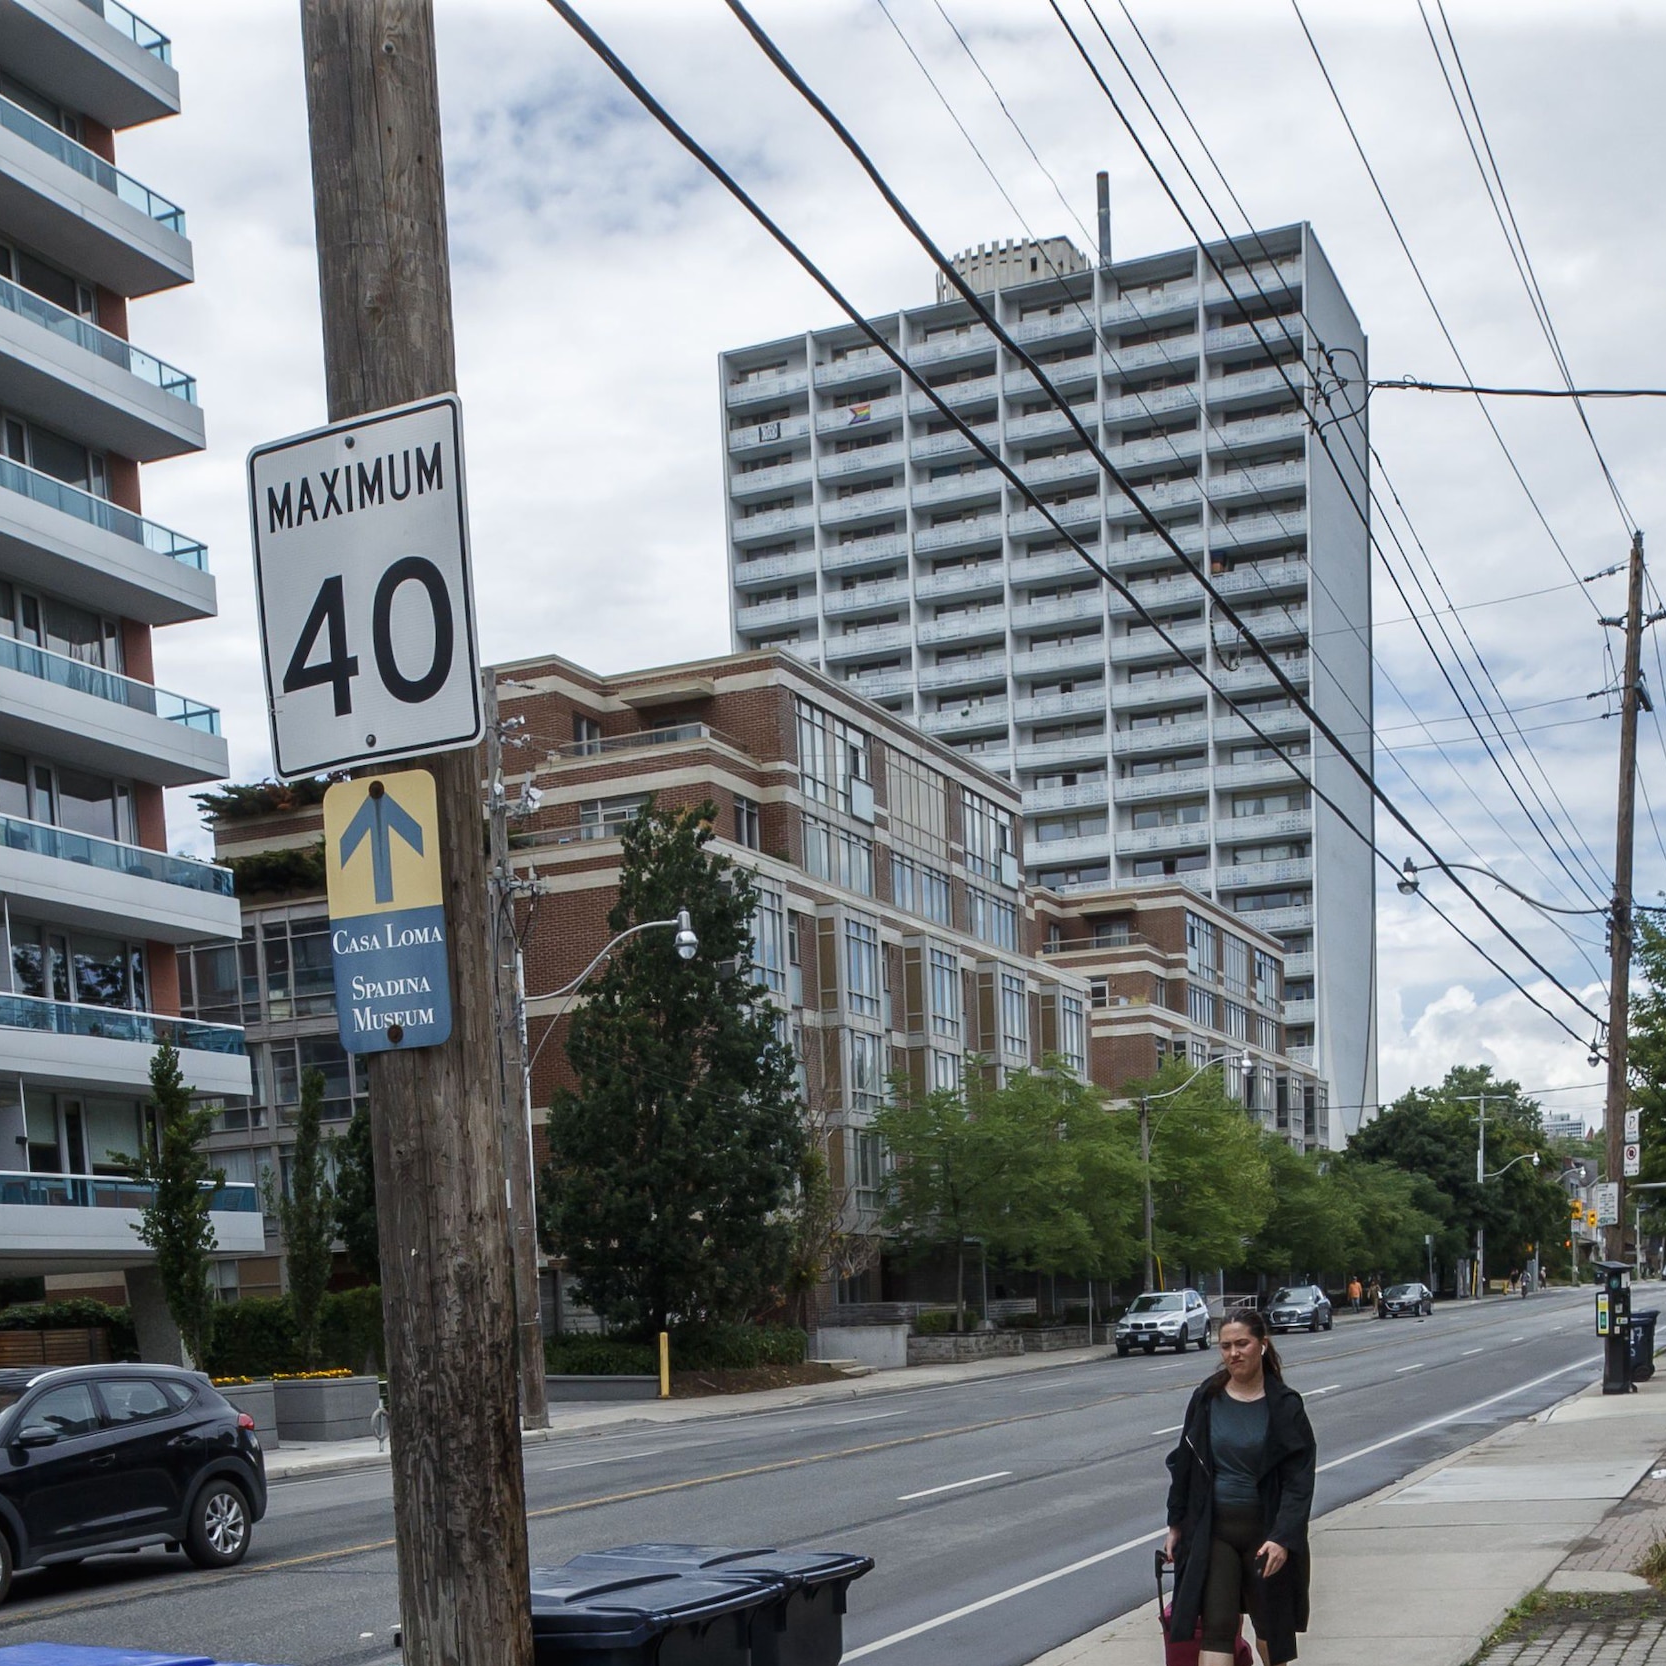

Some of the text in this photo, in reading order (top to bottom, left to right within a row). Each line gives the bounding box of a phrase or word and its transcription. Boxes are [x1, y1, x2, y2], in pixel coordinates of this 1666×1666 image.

[267, 442, 443, 533] MAXIMUM
[283, 556, 454, 717] 40
[332, 920, 444, 955] CASA LOMA
[351, 975, 432, 1001] SPADINA
[351, 1006, 436, 1034] MUSEUM
